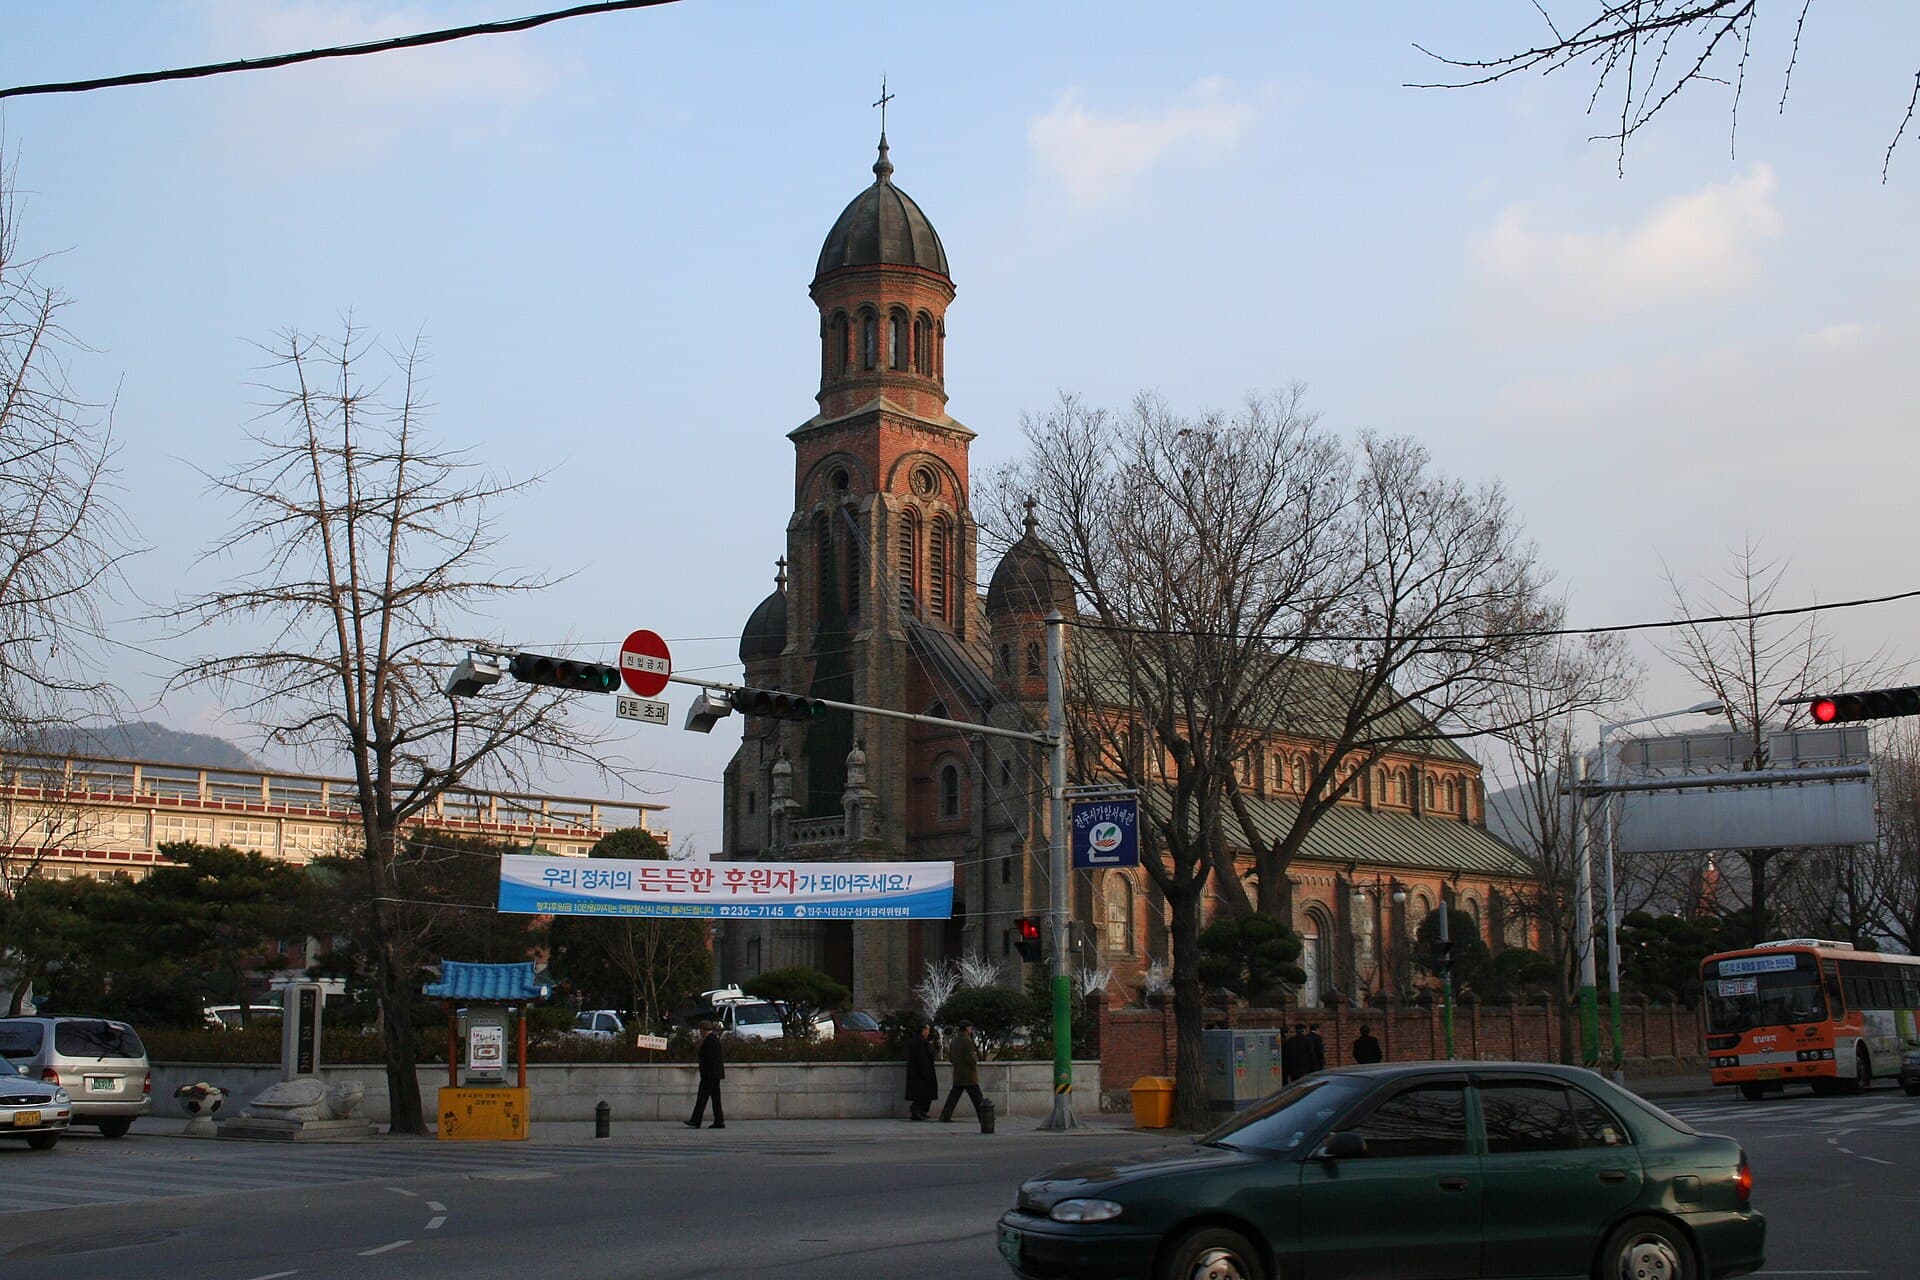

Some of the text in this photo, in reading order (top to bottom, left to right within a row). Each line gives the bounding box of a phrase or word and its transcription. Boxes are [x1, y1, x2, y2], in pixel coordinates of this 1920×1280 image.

[627, 656, 664, 671] 진입금지
[620, 701, 665, 720] 6톤 초과
[543, 867, 913, 895] 우리 정치의 든든한 후원자가 되어주세요!
